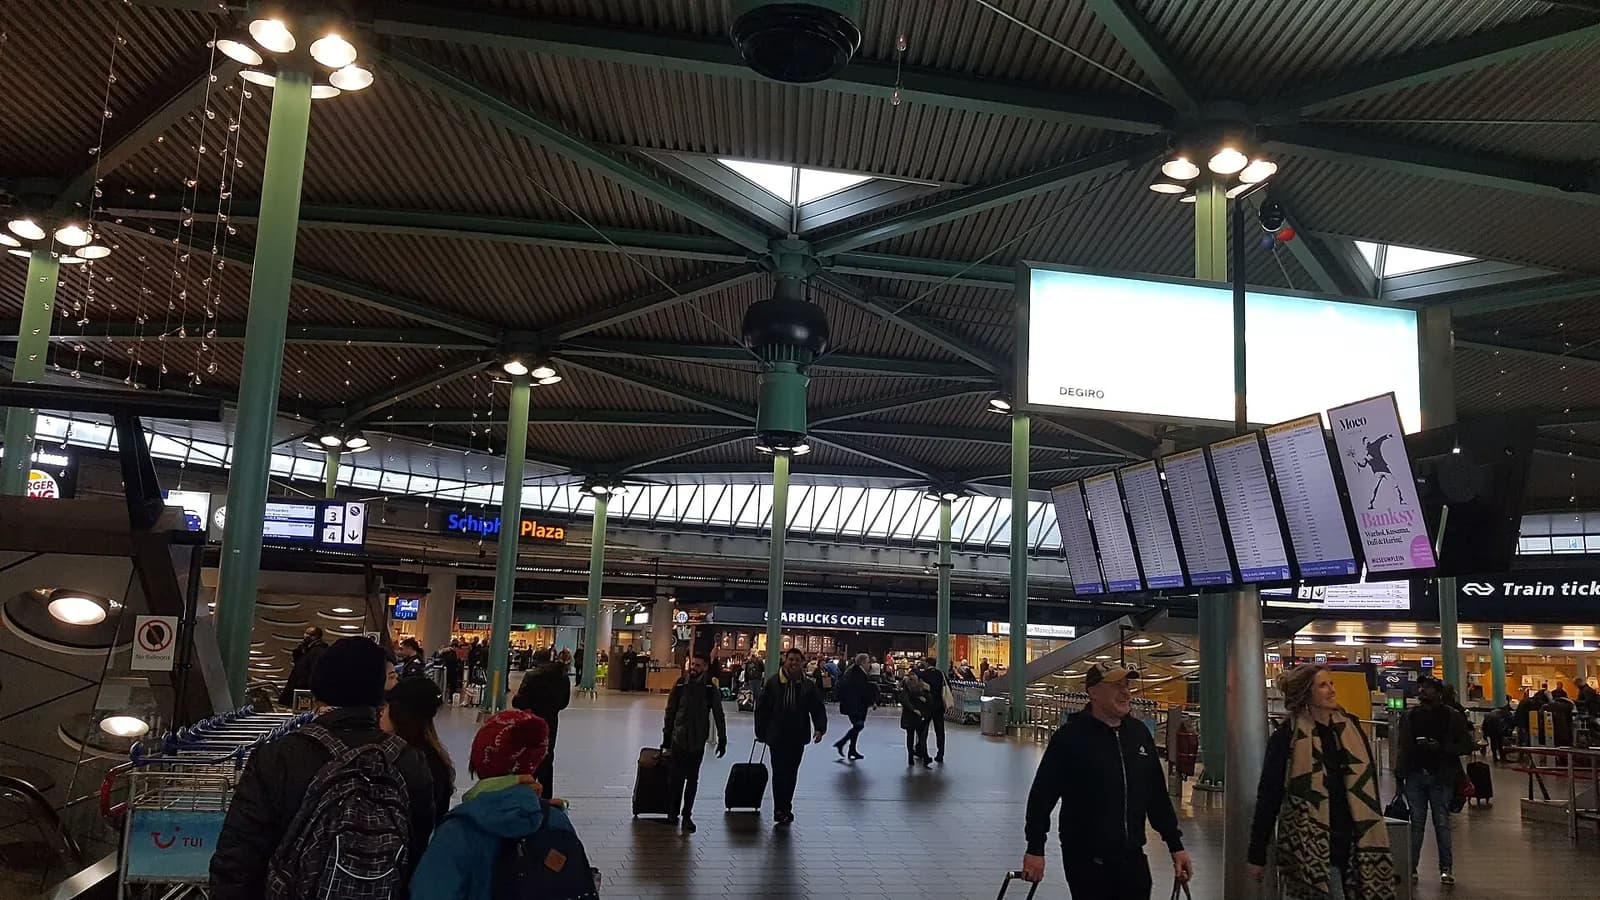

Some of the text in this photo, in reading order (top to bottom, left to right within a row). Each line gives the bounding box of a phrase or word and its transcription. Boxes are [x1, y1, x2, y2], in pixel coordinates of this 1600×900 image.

[1059, 386, 1105, 399] DEGIRO
[1339, 415, 1367, 432] Moco
[27, 480, 54, 490] RGER
[329, 512, 338, 522] 3
[1361, 507, 1415, 528] Banksy
[448, 514, 565, 540] Schiph Plaza
[328, 532, 337, 542] 4
[1301, 589, 1308, 598] 2
[1503, 581, 1555, 596] Train
[764, 612, 885, 627] SARBUCKS COFFEE
[182, 837, 203, 847] TUI
